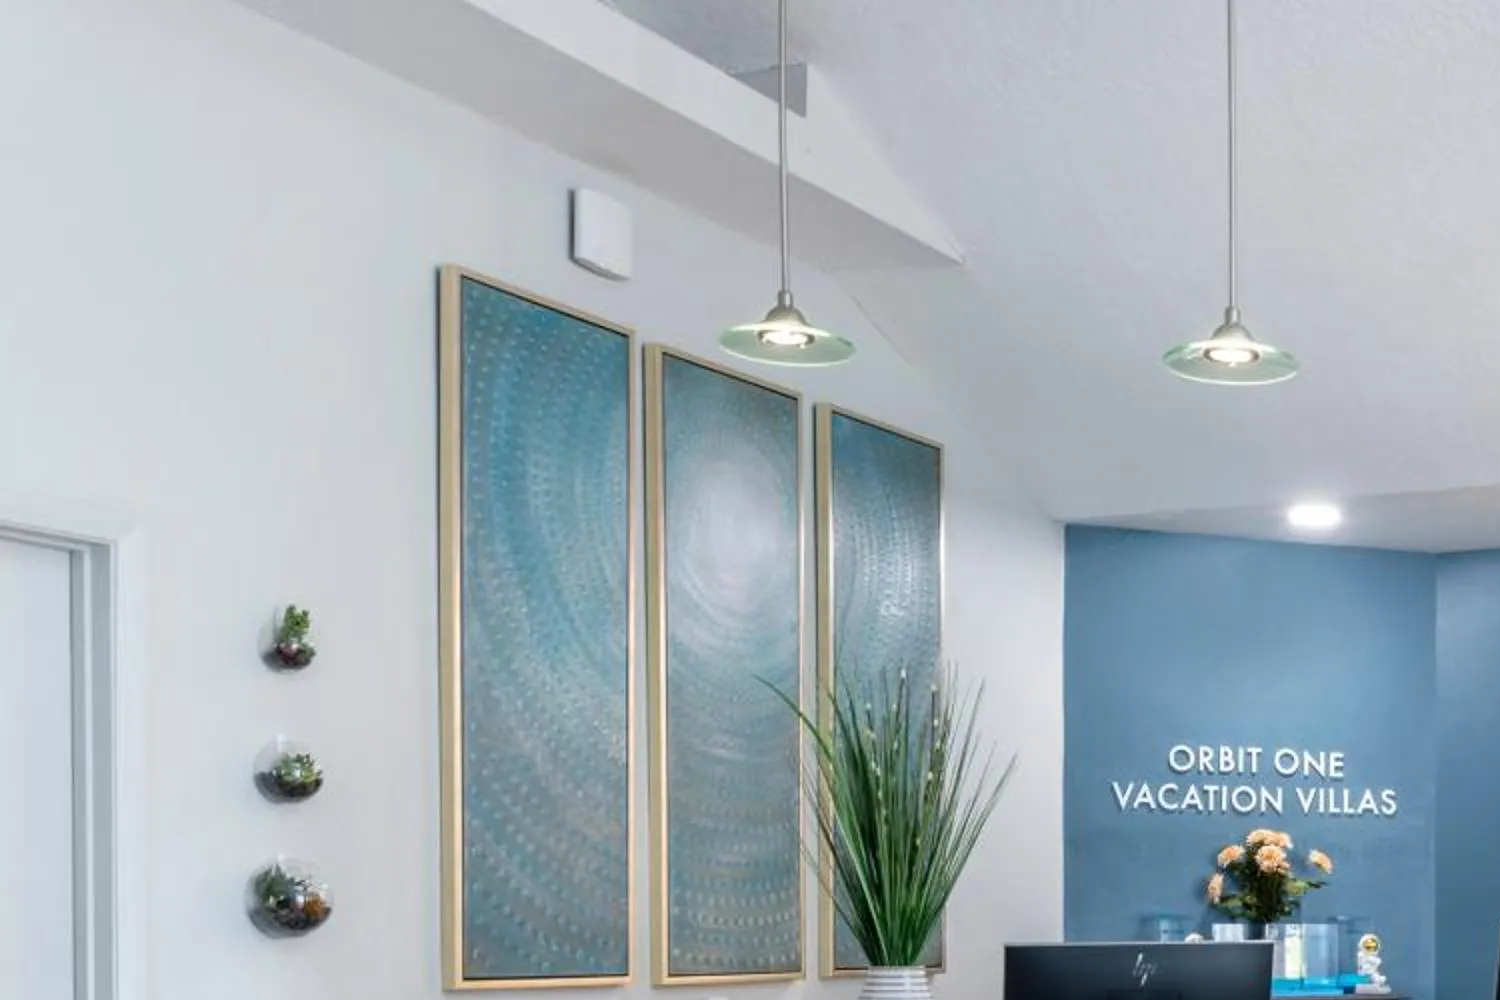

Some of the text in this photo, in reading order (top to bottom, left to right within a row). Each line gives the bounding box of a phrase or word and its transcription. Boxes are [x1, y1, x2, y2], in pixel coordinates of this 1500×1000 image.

[1168, 744, 1345, 778] ORBIT ONE
[1111, 781, 1398, 816] VACATION VILLAS
